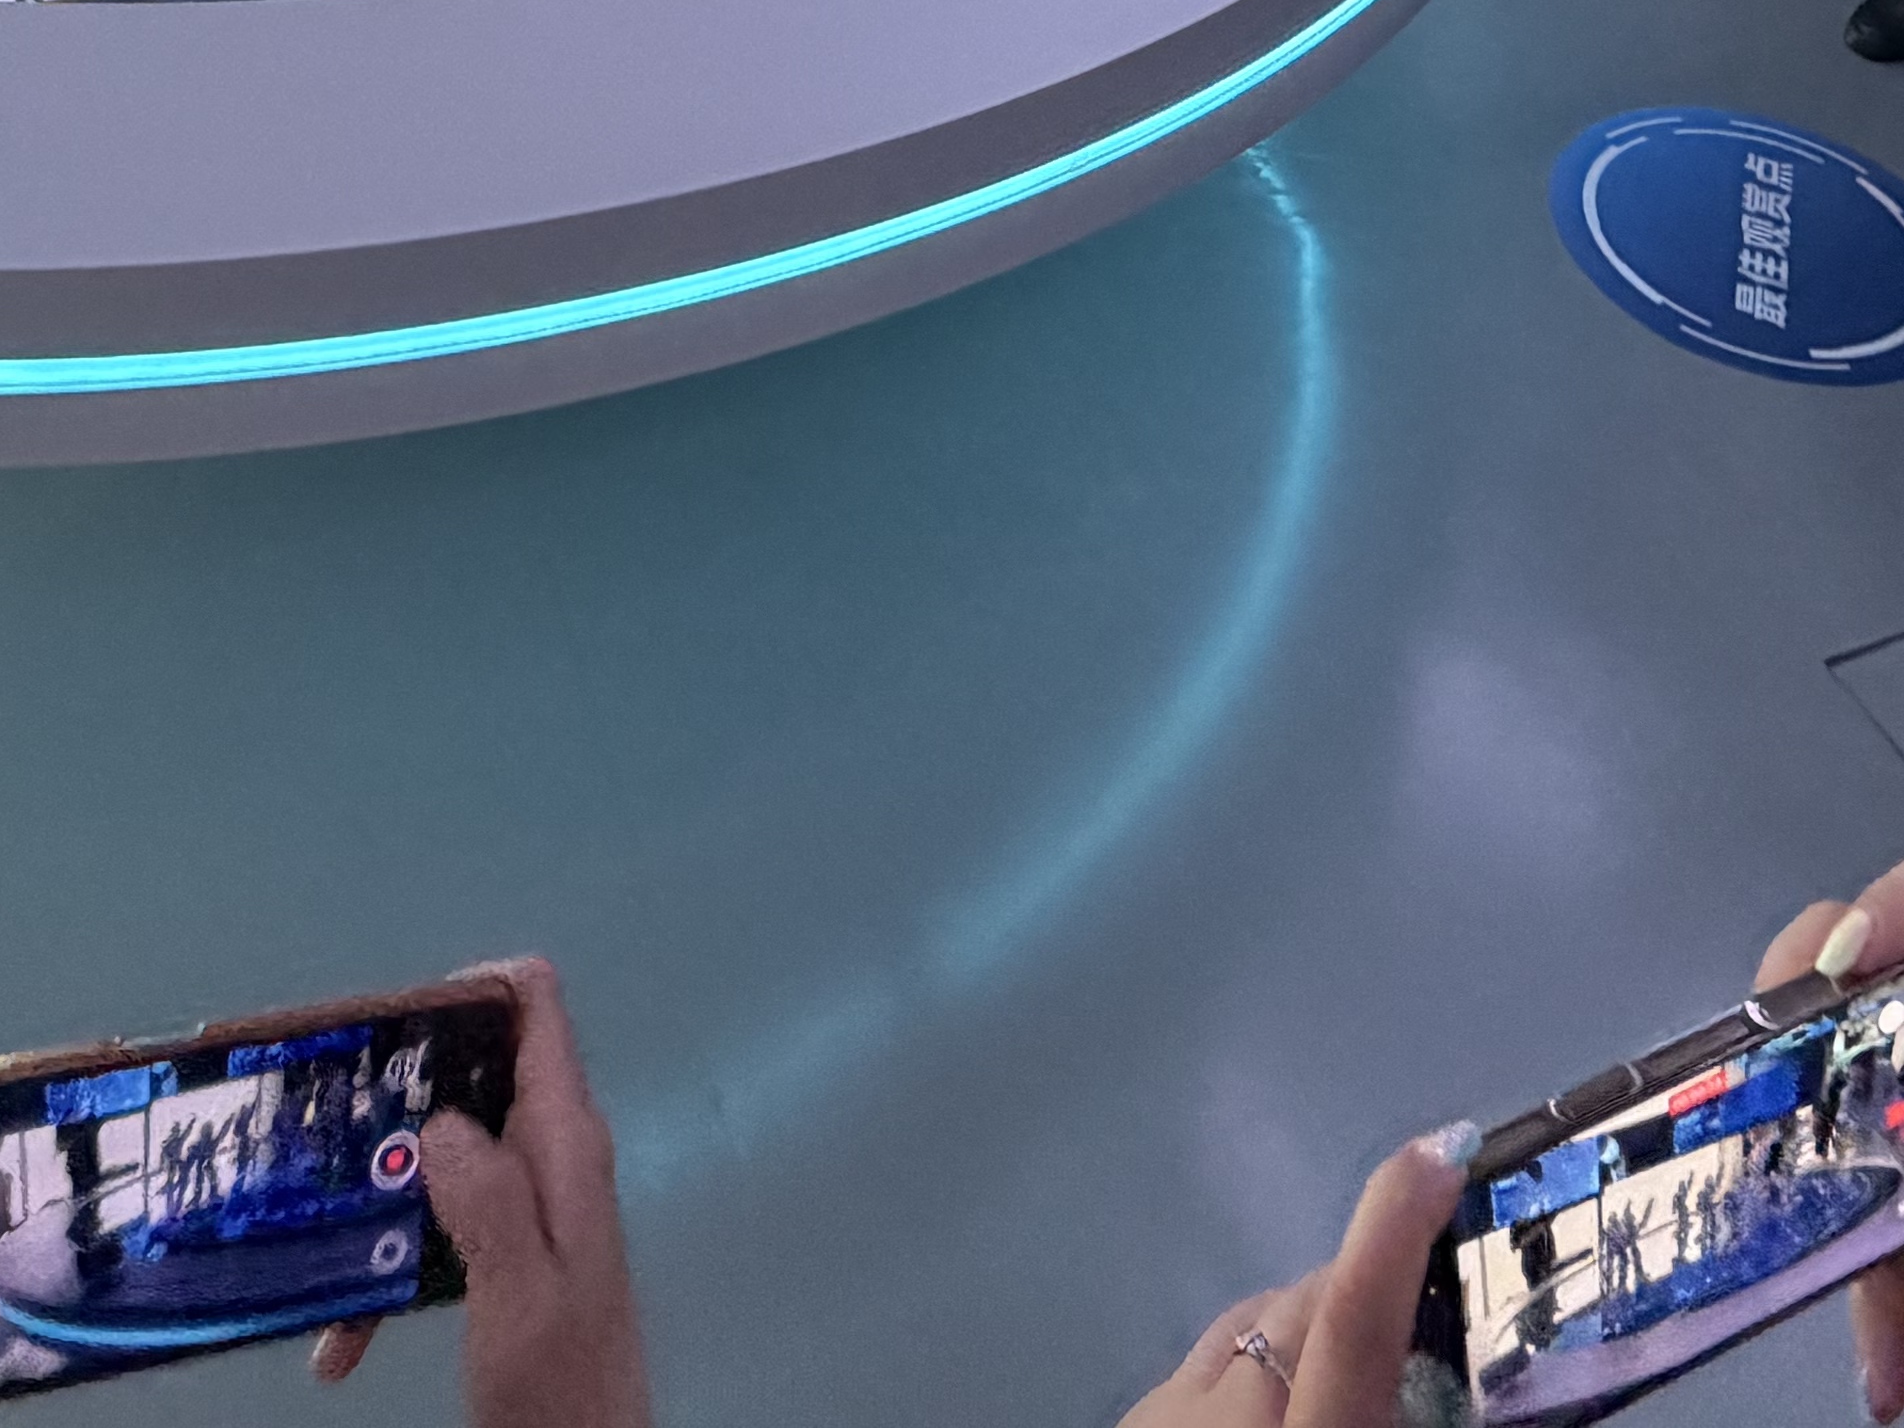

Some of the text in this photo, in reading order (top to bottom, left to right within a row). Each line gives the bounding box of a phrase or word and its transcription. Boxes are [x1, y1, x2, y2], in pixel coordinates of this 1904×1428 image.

[1734, 152, 1794, 329] 最佳观赏点
